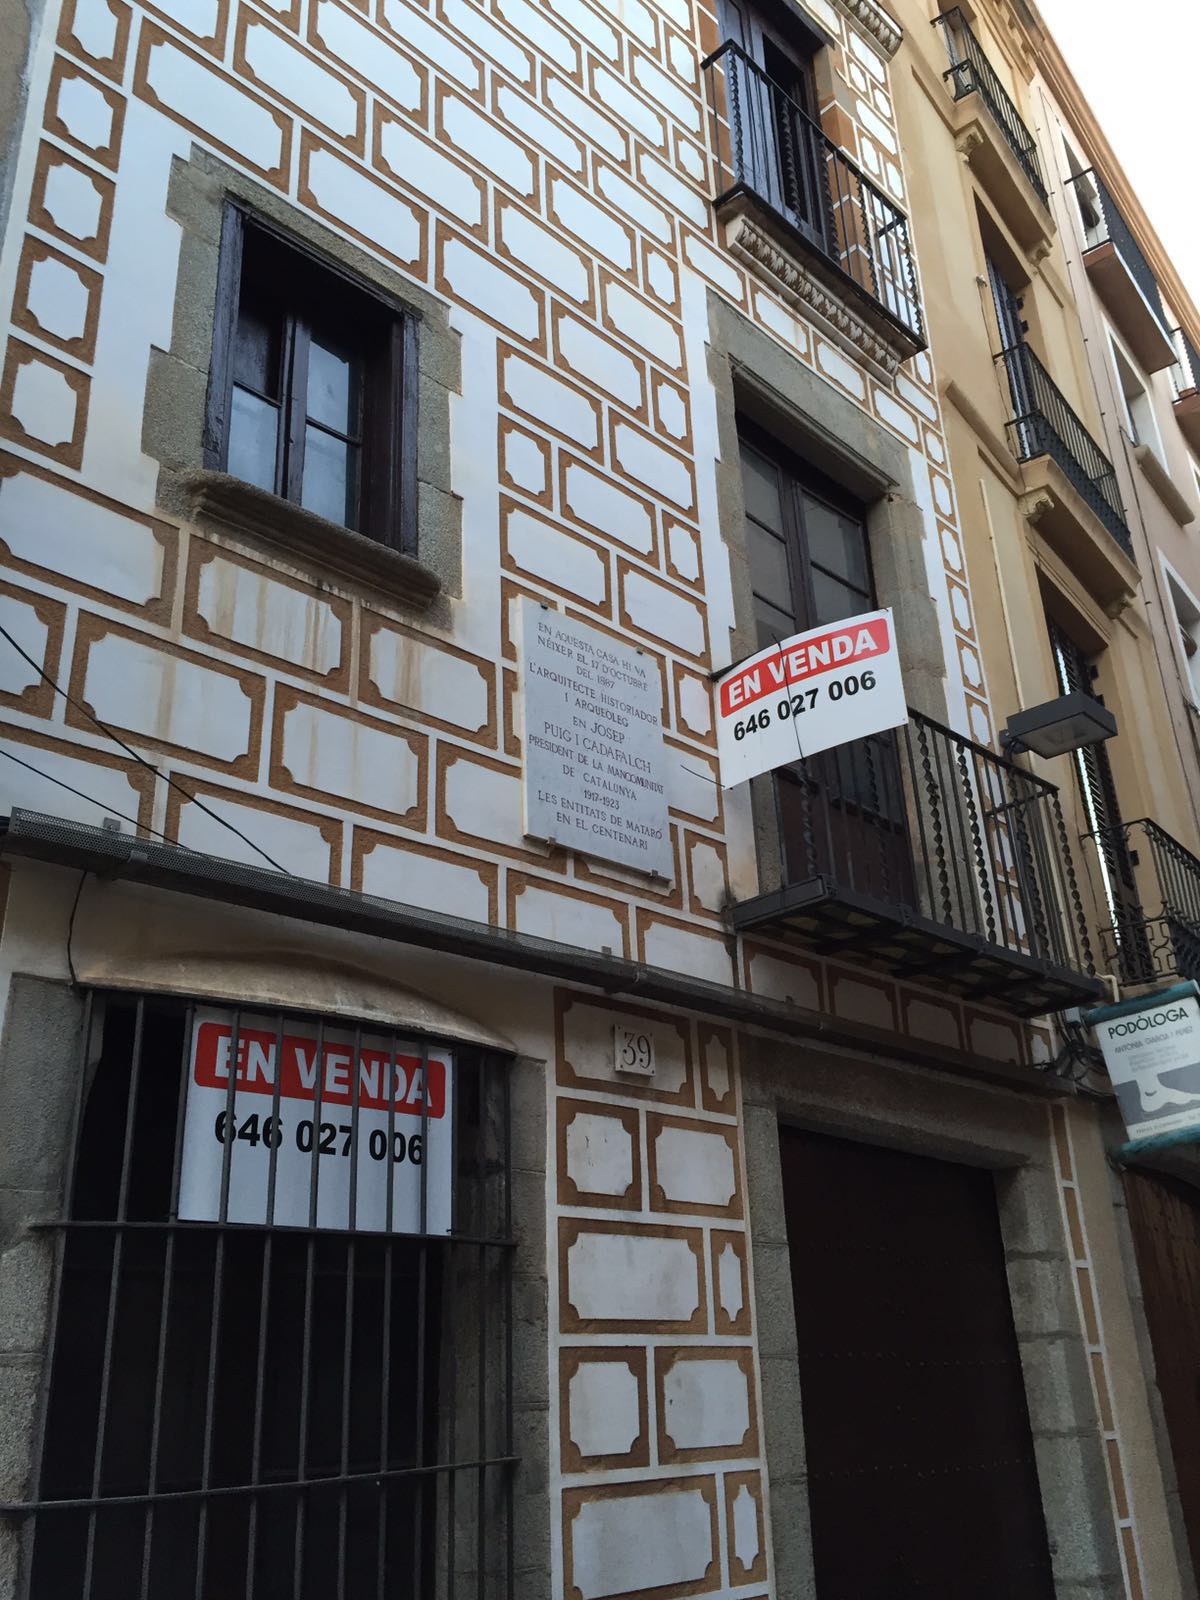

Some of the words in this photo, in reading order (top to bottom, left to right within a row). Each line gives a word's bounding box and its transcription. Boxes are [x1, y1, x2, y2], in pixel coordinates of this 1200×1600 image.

[537, 622, 552, 635] EN
[555, 630, 595, 656] AQUESTA
[596, 648, 619, 665] CASA
[622, 660, 632, 671] HI
[634, 665, 646, 678] VA
[537, 635, 573, 659] NÉIXER
[577, 653, 588, 666] EL
[591, 660, 599, 669] 17
[602, 664, 649, 692] D'OCTUBRE
[576, 665, 594, 680] DEL
[728, 669, 761, 708] EN
[767, 629, 878, 684] VENDA
[529, 662, 596, 699] L'ARQUITECTE
[600, 693, 658, 726] HISTORIADOR
[564, 692, 569, 702] I
[734, 708, 771, 741] 646
[777, 687, 819, 720] 027
[828, 670, 876, 701] 006
[528, 734, 574, 759] PRESIDENT
[577, 753, 589, 765] DE
[592, 759, 603, 771] LA
[544, 721, 572, 742] PUIG
[575, 733, 580, 746] I
[582, 737, 652, 773] CADAFALCH
[572, 716, 586, 728] EN
[590, 722, 625, 744] JOSEP
[562, 764, 575, 777] DE
[583, 772, 637, 801] CATALUNYA
[583, 789, 620, 810] 1917-1923
[538, 790, 558, 805] LES
[560, 797, 607, 822] ENTITATS
[610, 814, 623, 827] DE
[626, 819, 663, 840] MATARÓ
[556, 811, 571, 825] EN
[576, 818, 588, 831] EL
[592, 823, 648, 851] CENTENARI
[1108, 1007, 1189, 1039] PODÒLOGA
[214, 1036, 278, 1084] EN
[294, 1048, 433, 1108] VENDA
[622, 1031, 652, 1069] 39
[214, 1110, 283, 1150] 646
[295, 1120, 356, 1157] 027
[368, 1129, 426, 1166] 006
